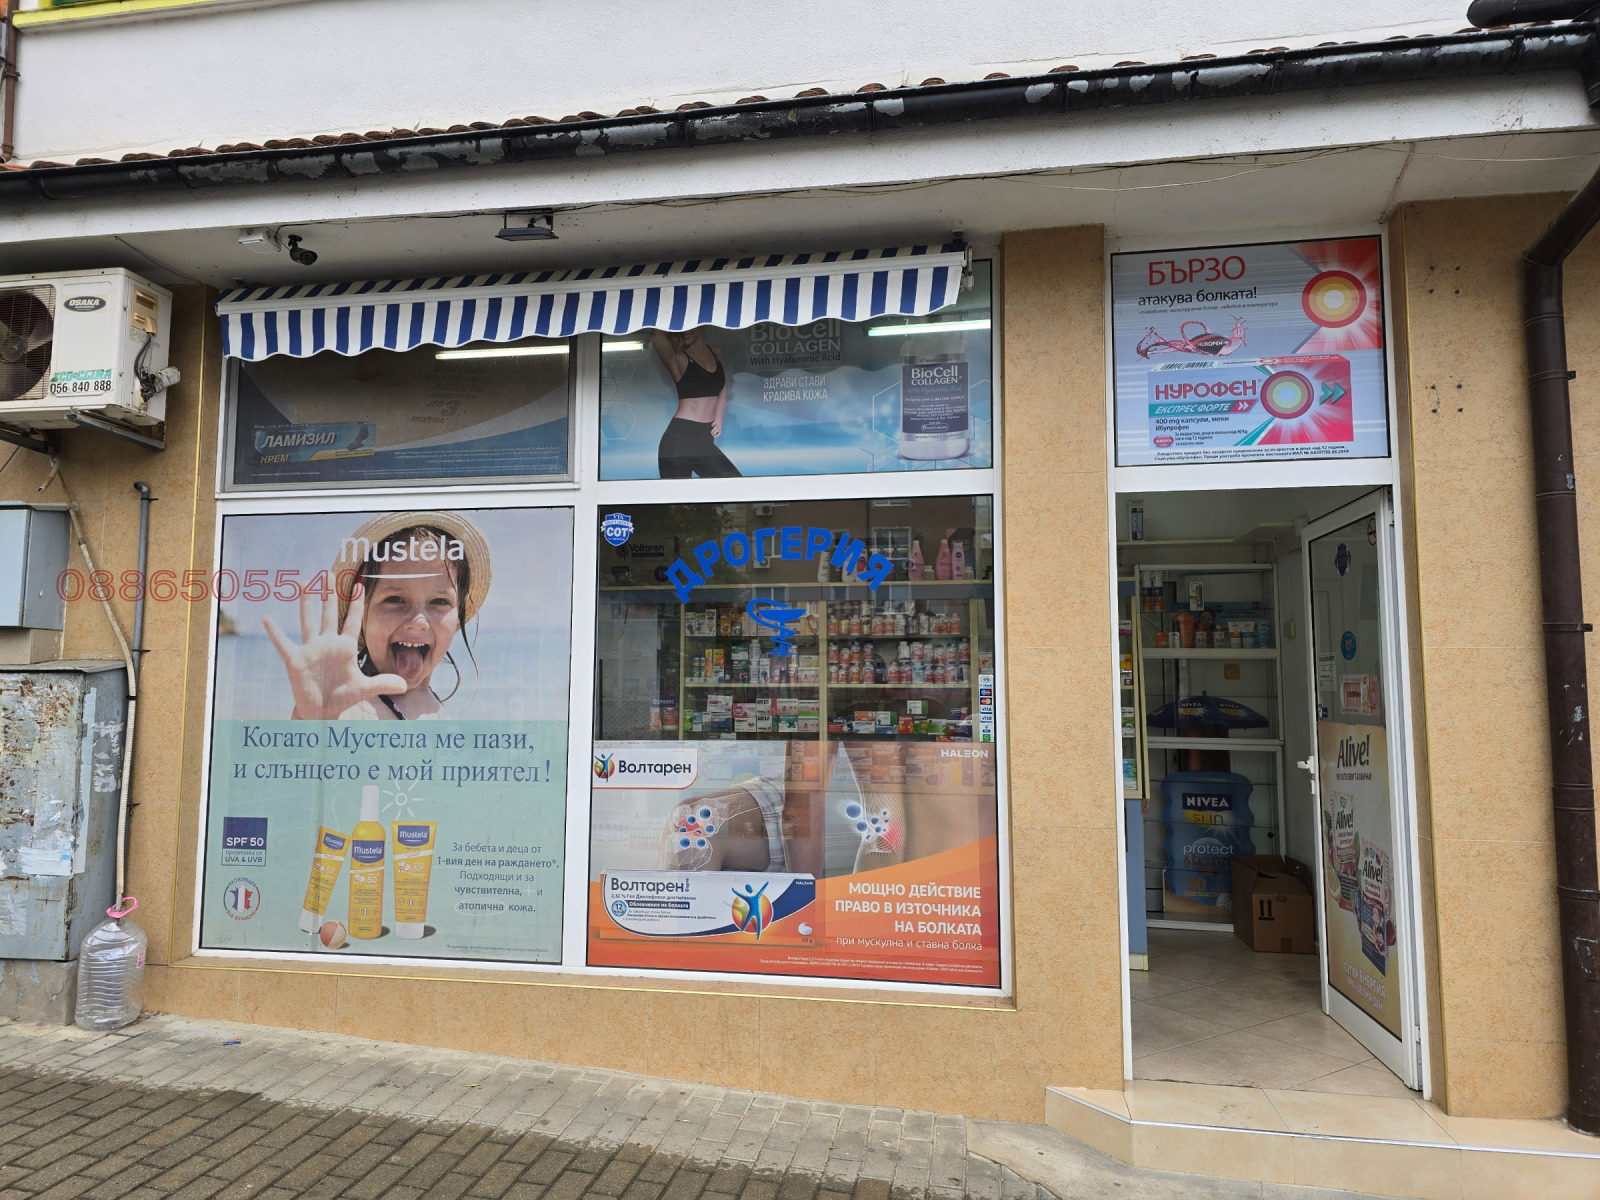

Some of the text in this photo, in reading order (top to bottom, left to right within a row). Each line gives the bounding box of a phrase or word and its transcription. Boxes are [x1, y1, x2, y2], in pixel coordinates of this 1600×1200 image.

[1148, 255, 1246, 286] БЪРЗО
[69, 298, 100, 307] OSAKA
[1138, 286, 1257, 307] атакува болката!
[750, 339, 841, 355] COLLAGEN
[750, 353, 841, 367] With Hyaluronic Acid
[911, 365, 958, 379] BioCell
[50, 380, 112, 393] 056 840 888
[763, 375, 826, 389] ЗДРАВИ СТАВИ
[911, 376, 958, 386] COLLAGEN
[763, 389, 828, 402] КРАСИВА КОЖА
[1155, 379, 1257, 401] НУРОФЕН
[1155, 402, 1231, 415] ЕКСПРЕС ФОРТЕ
[260, 432, 336, 449] ЛАМИЗИЛ
[260, 454, 289, 464] КРЕМ
[606, 527, 629, 537] СОТ
[665, 526, 894, 605] ДРОГЕРИЯ
[242, 726, 535, 754] Когато Мустела ме пази,
[940, 749, 989, 758] HALEON
[1337, 734, 1370, 768] Alive!
[233, 763, 247, 779] и
[254, 763, 360, 783] слънцето
[368, 763, 380, 781] е
[387, 759, 434, 782] мой
[618, 760, 692, 779] Волтарен
[1186, 796, 1230, 808] NIVEA
[1335, 809, 1354, 830] Alive!
[226, 837, 264, 847] SPF 50
[452, 843, 463, 852] За
[464, 842, 496, 853] бебета
[506, 845, 529, 855] деца
[530, 845, 542, 854] от
[1183, 844, 1234, 855] protect
[437, 856, 463, 865] 1-вия
[464, 857, 483, 867] ден
[459, 871, 514, 882] Подходящи
[524, 874, 534, 882] за
[1362, 859, 1383, 883] Alive!
[611, 877, 684, 894] Волтарен
[849, 882, 981, 899] МОЩНО ДЕЙСТВИЕ
[1186, 877, 1207, 891] 30
[454, 887, 523, 897] чувствителна,
[458, 902, 536, 913] атопична кожа.
[835, 900, 981, 917] ПРАВО В ИЗТОЧНИКА
[894, 920, 982, 936] НА БОЛКАТА
[836, 937, 982, 951] при мускулна и ставна болка
